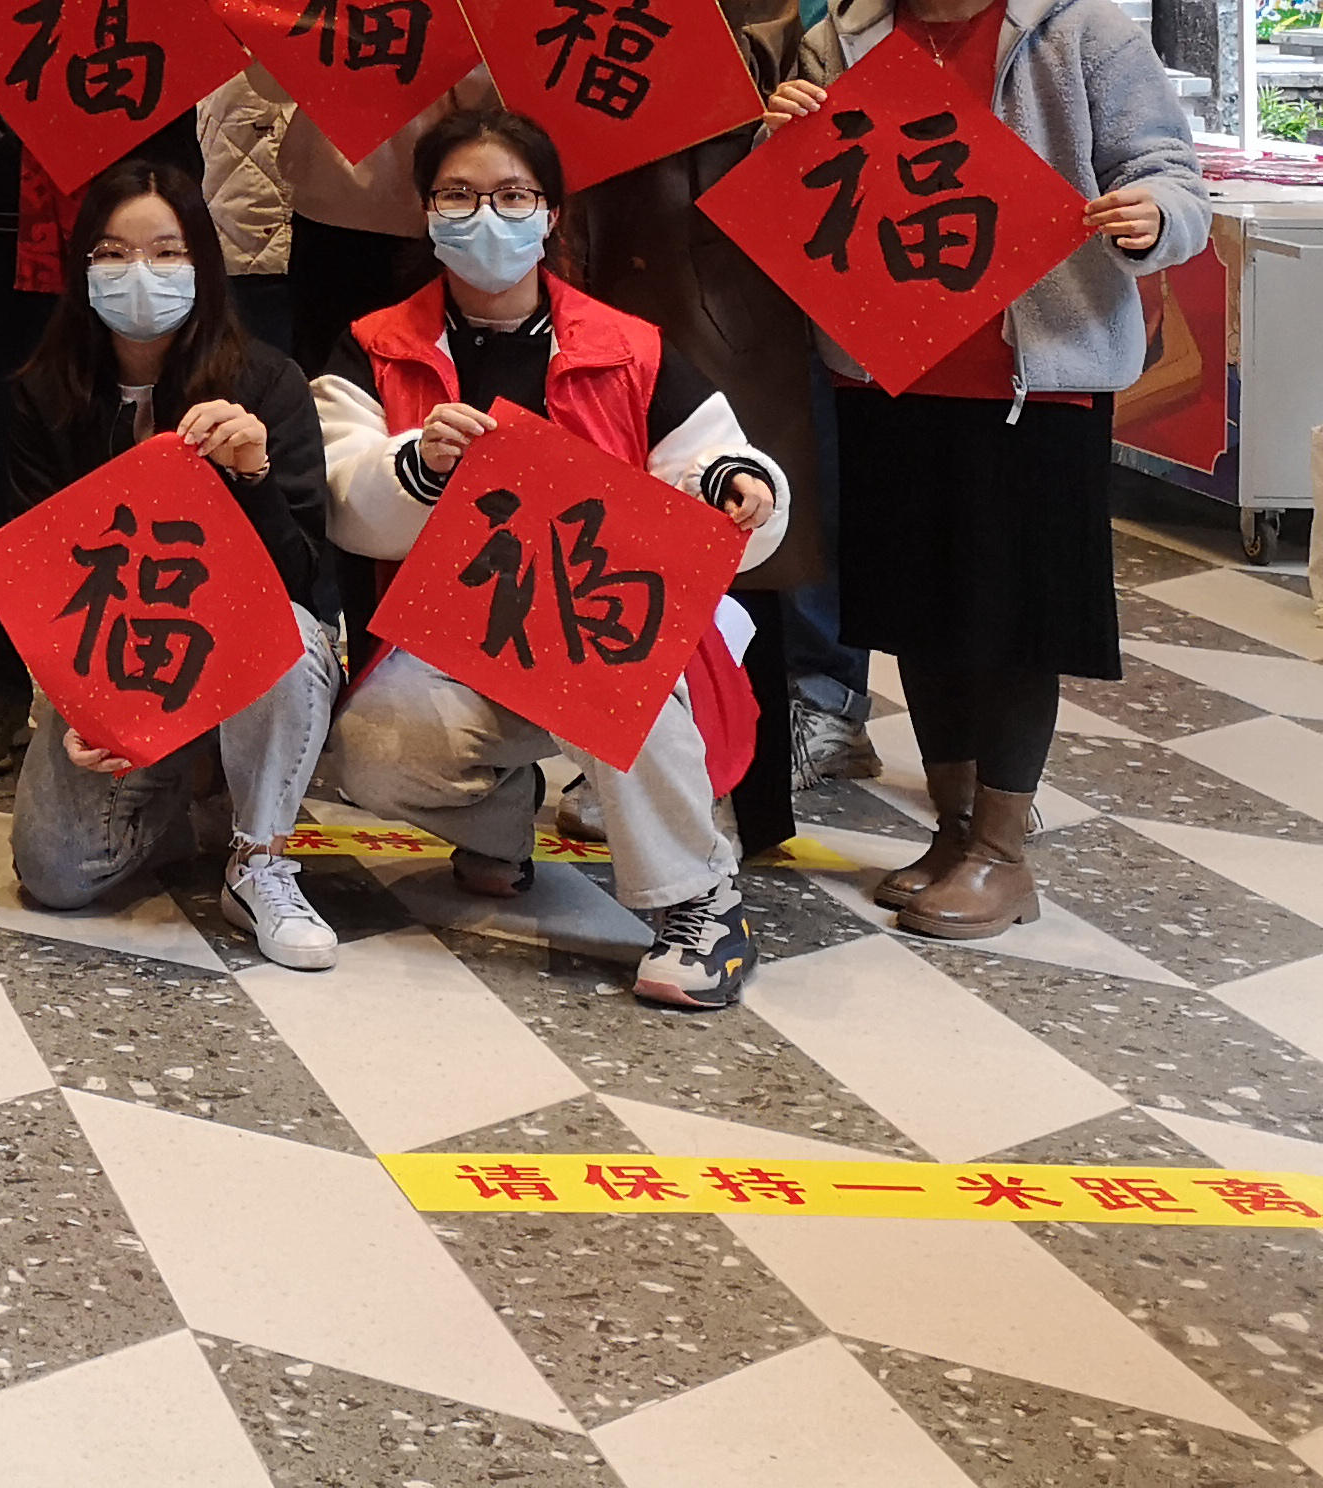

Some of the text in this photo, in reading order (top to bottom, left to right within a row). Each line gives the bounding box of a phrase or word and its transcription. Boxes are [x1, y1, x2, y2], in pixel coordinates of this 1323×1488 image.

[802, 110, 998, 292] 福
[62, 505, 214, 711] 福
[459, 489, 664, 668] 福
[456, 1163, 1323, 1218] 请保持一米距离
